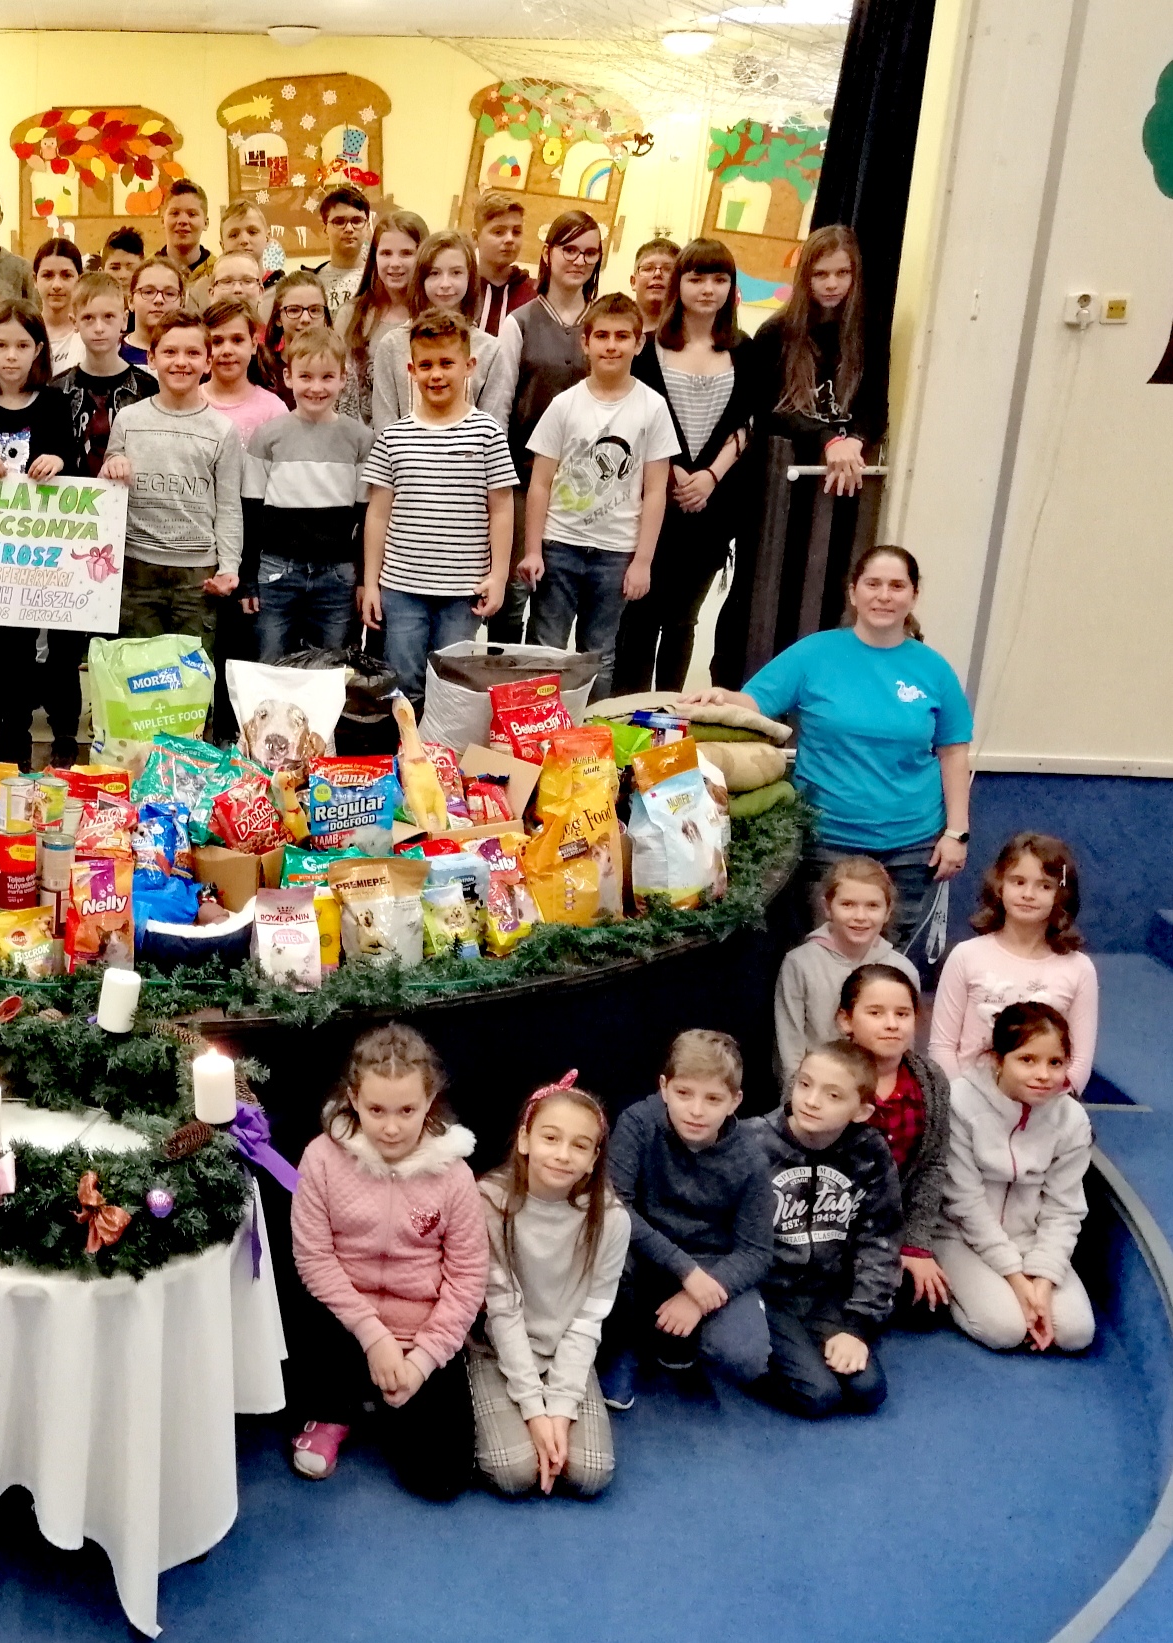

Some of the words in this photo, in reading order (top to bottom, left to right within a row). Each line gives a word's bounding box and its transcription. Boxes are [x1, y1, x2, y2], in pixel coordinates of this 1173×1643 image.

[134, 473, 210, 497] EGEND
[20, 586, 94, 609] LÁSZLÓ
[19, 608, 72, 622] ISKOLA
[133, 714, 175, 731] MPLETE
[178, 708, 206, 723] FOOD
[510, 716, 561, 737] Bellosan
[333, 773, 369, 786] panzi
[315, 796, 386, 822] Regular
[583, 801, 613, 831] Food
[329, 814, 377, 831] DOGFOOD
[82, 895, 128, 915] Nelly
[260, 914, 283, 923] ROYAL
[285, 913, 310, 922] CANIN
[275, 934, 305, 942] KITTEN
[776, 1168, 806, 1185] SPEED
[781, 1218, 804, 1231] EST.
[812, 1213, 838, 1224] 1949
[813, 1231, 843, 1240] CLASSIC
